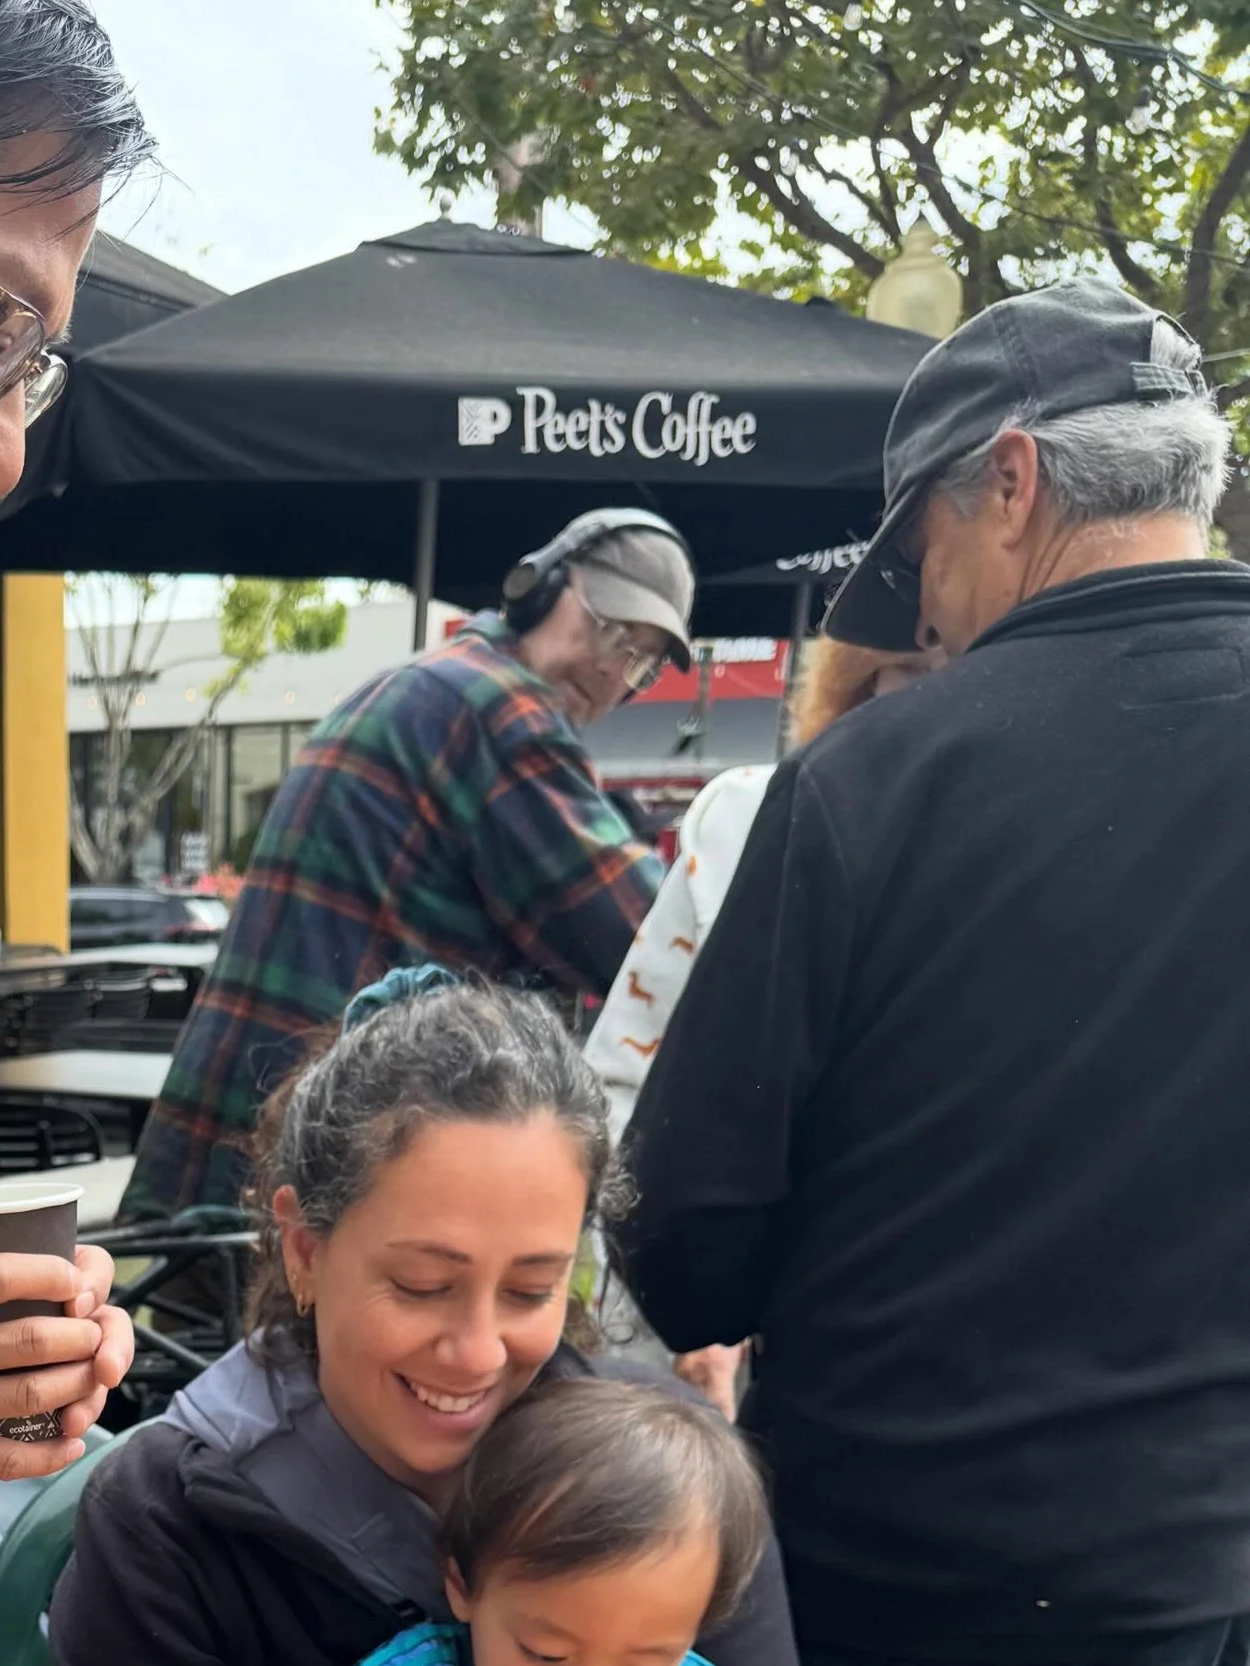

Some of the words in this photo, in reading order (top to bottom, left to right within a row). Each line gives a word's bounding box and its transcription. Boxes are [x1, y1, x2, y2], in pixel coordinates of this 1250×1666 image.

[516, 387, 626, 457] Peet's
[632, 391, 756, 466] Coffee
[8, 1422, 42, 1434] ecotainer
